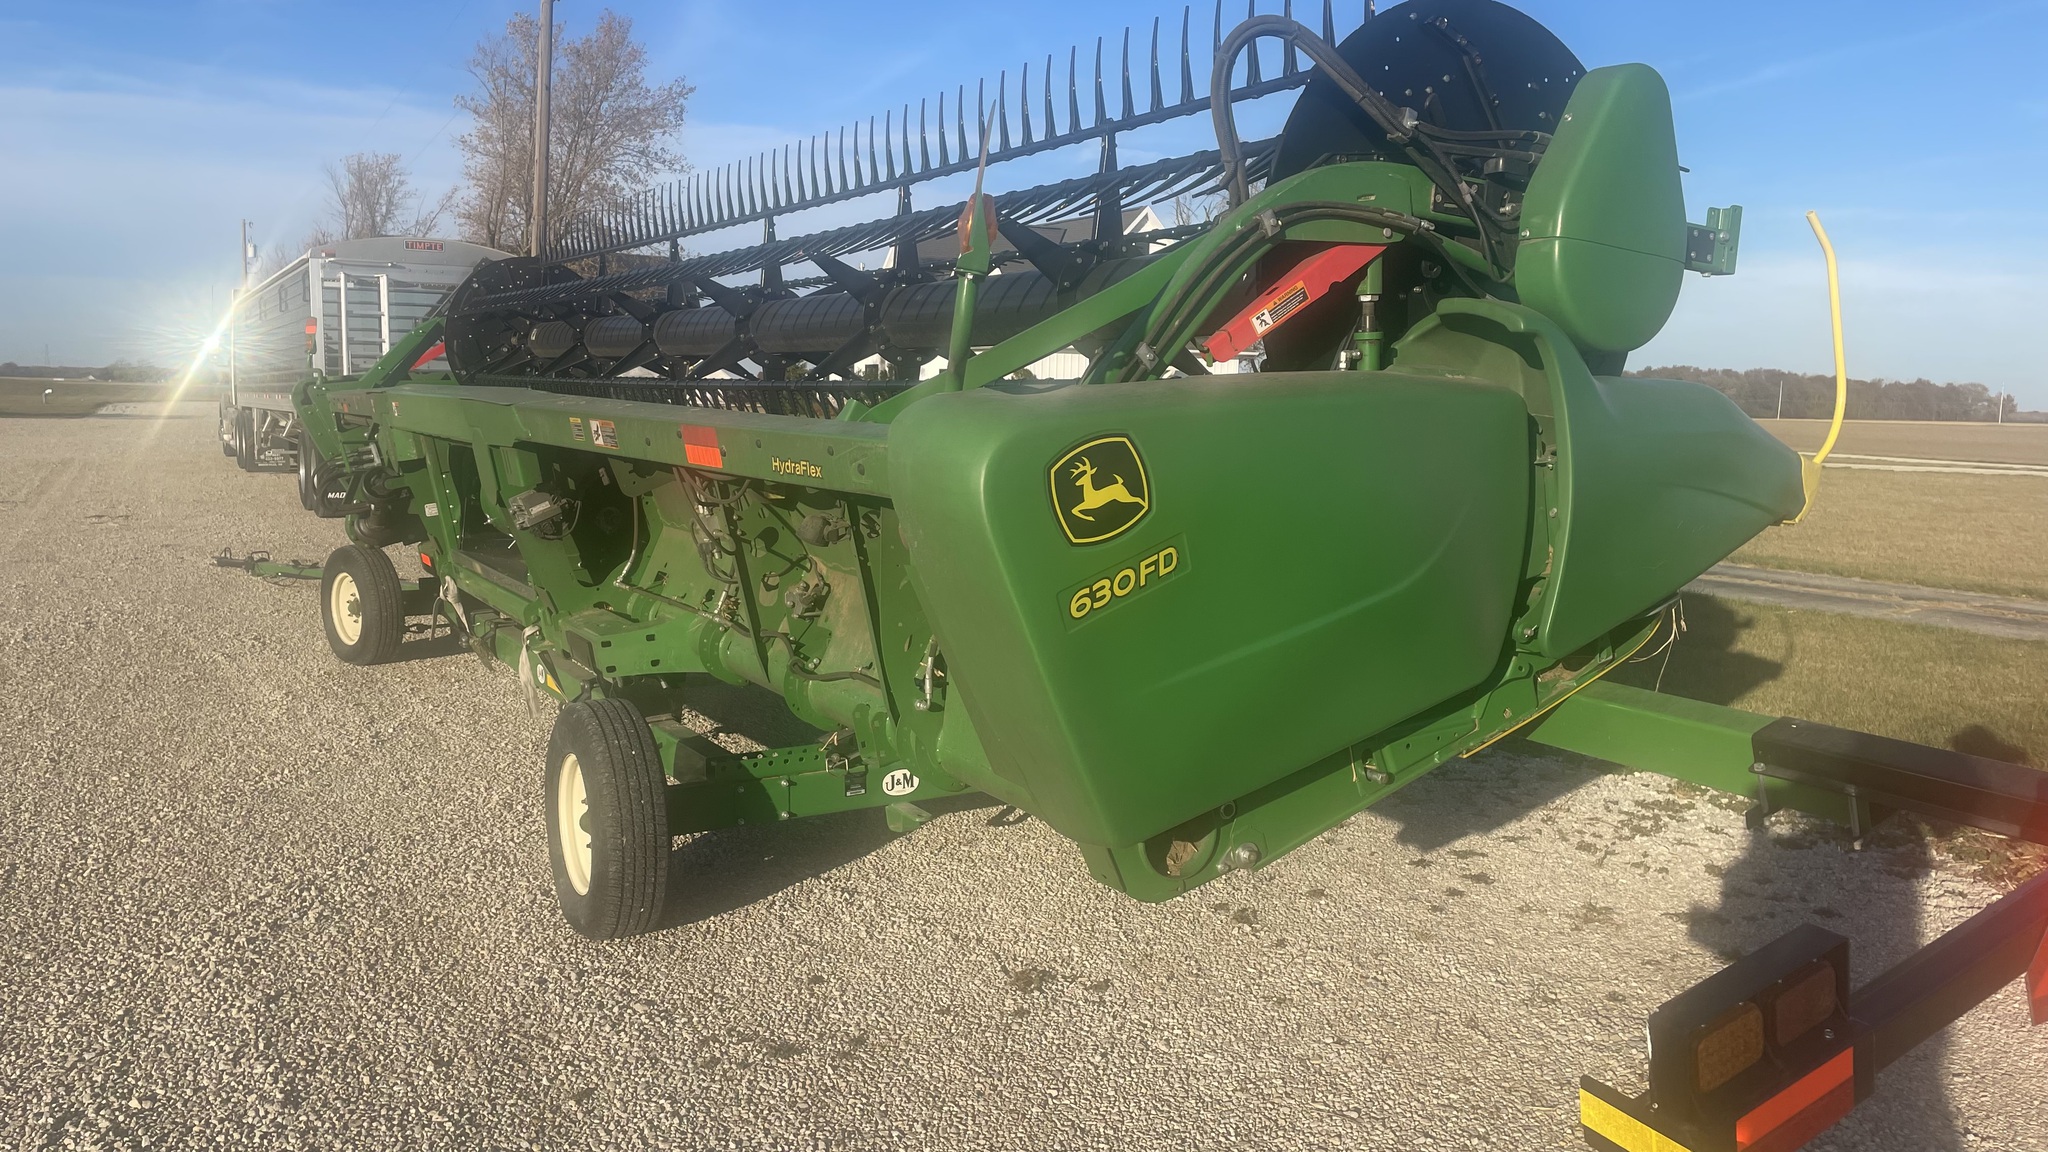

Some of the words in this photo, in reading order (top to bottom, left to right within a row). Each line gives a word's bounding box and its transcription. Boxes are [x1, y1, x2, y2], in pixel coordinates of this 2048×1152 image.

[406, 241, 443, 251] TIMPTE
[771, 456, 823, 478] HydraFlex
[885, 772, 915, 792] J&M
